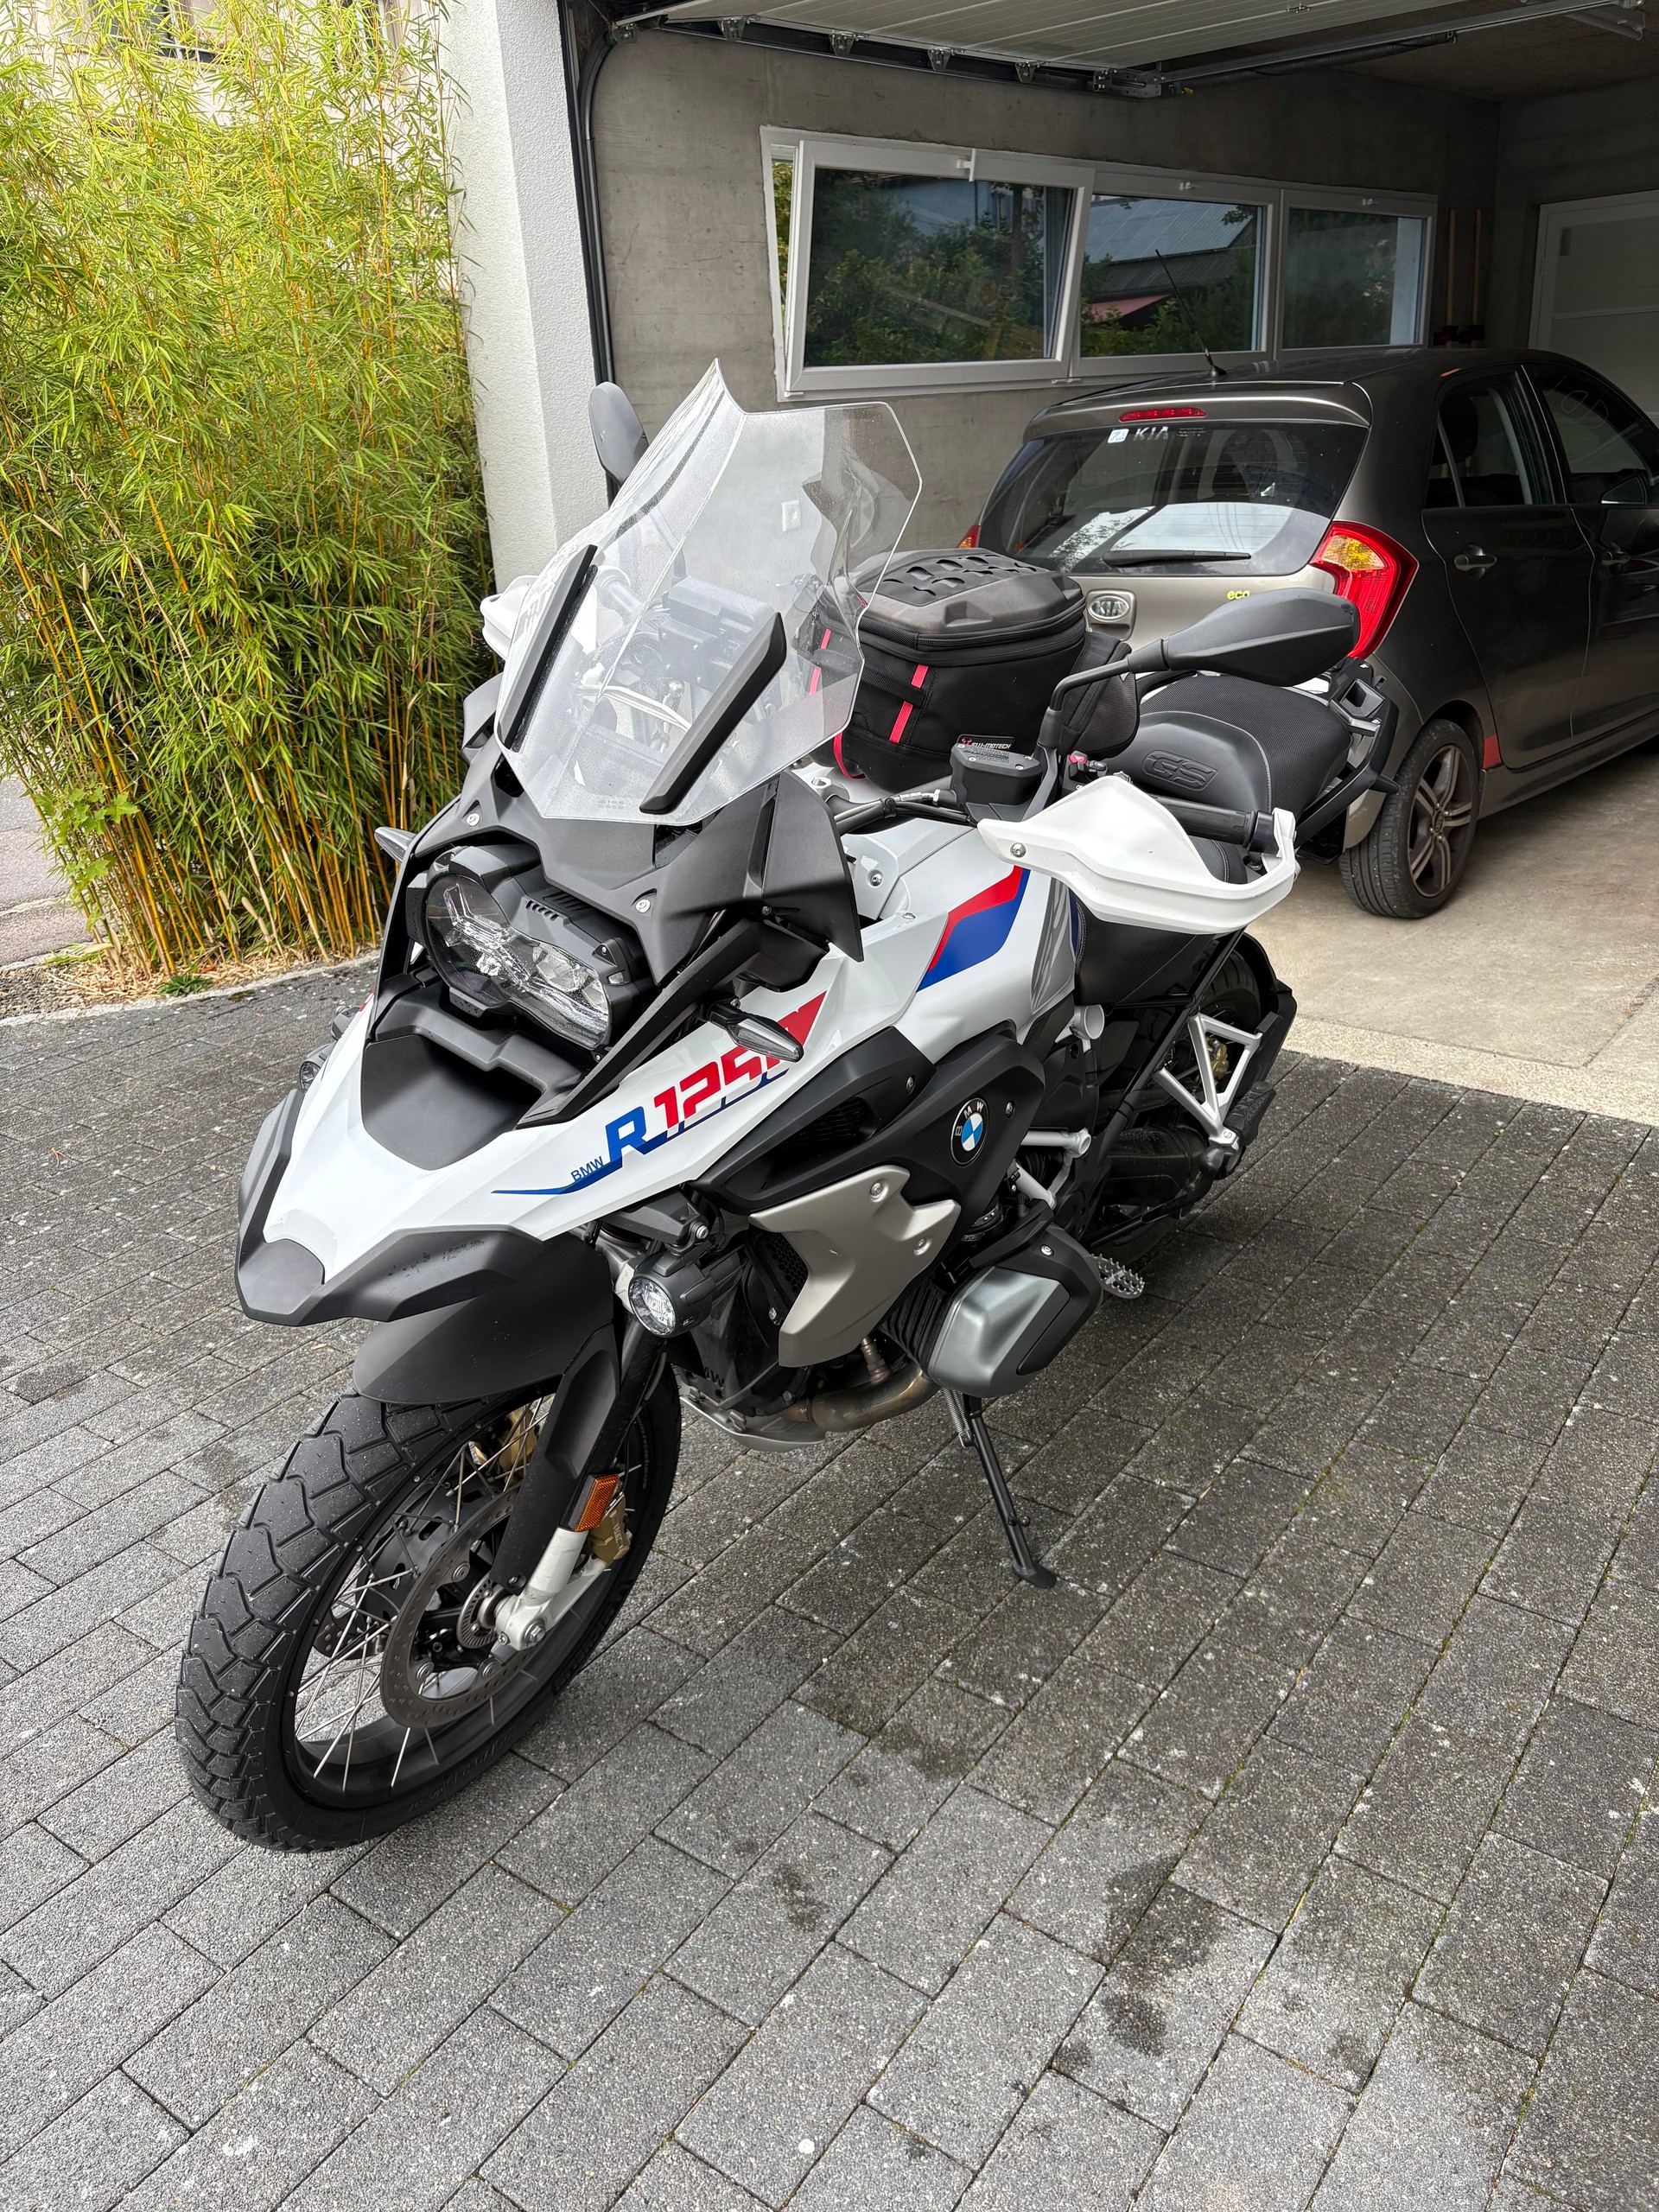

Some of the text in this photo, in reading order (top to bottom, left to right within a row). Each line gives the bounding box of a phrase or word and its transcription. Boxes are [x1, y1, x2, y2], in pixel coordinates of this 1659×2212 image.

[1133, 426, 1169, 442] KIA
[1227, 590, 1250, 600] eco
[1145, 752, 1213, 789] GS
[955, 1101, 984, 1136] BMW
[570, 1156, 604, 1183] BMW
[605, 1106, 647, 1164] R
